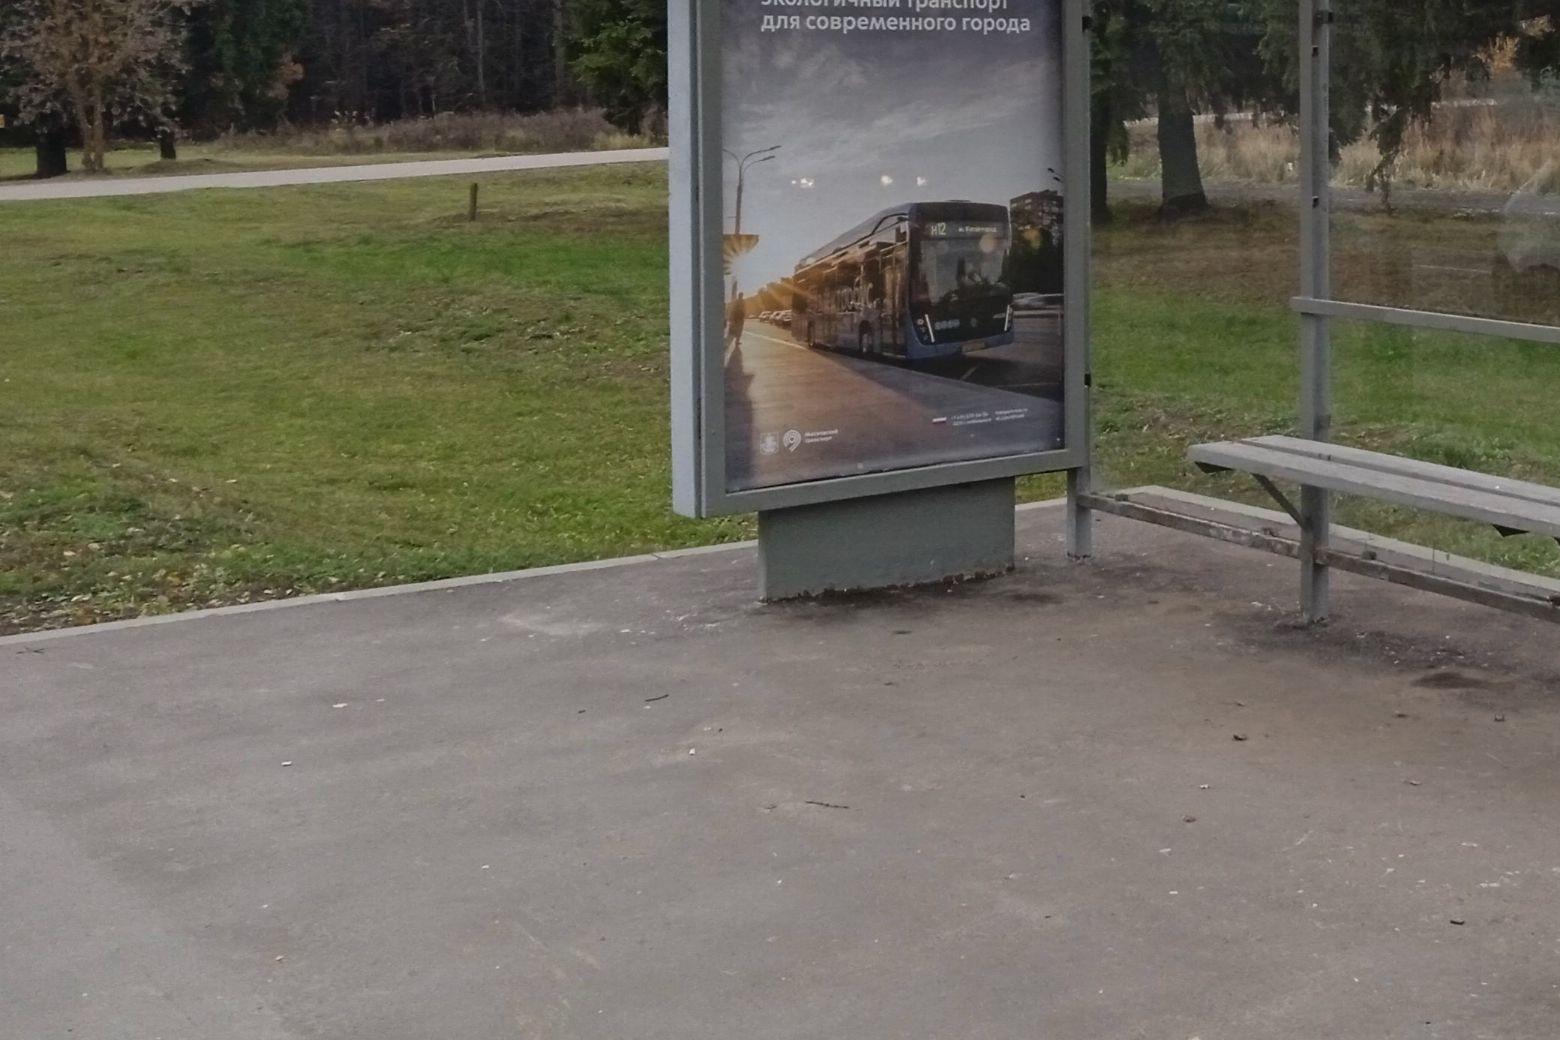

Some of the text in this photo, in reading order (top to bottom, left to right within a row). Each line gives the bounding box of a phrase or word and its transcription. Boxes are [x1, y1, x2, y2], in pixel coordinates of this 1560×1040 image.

[761, 14, 1031, 35] для современного города
